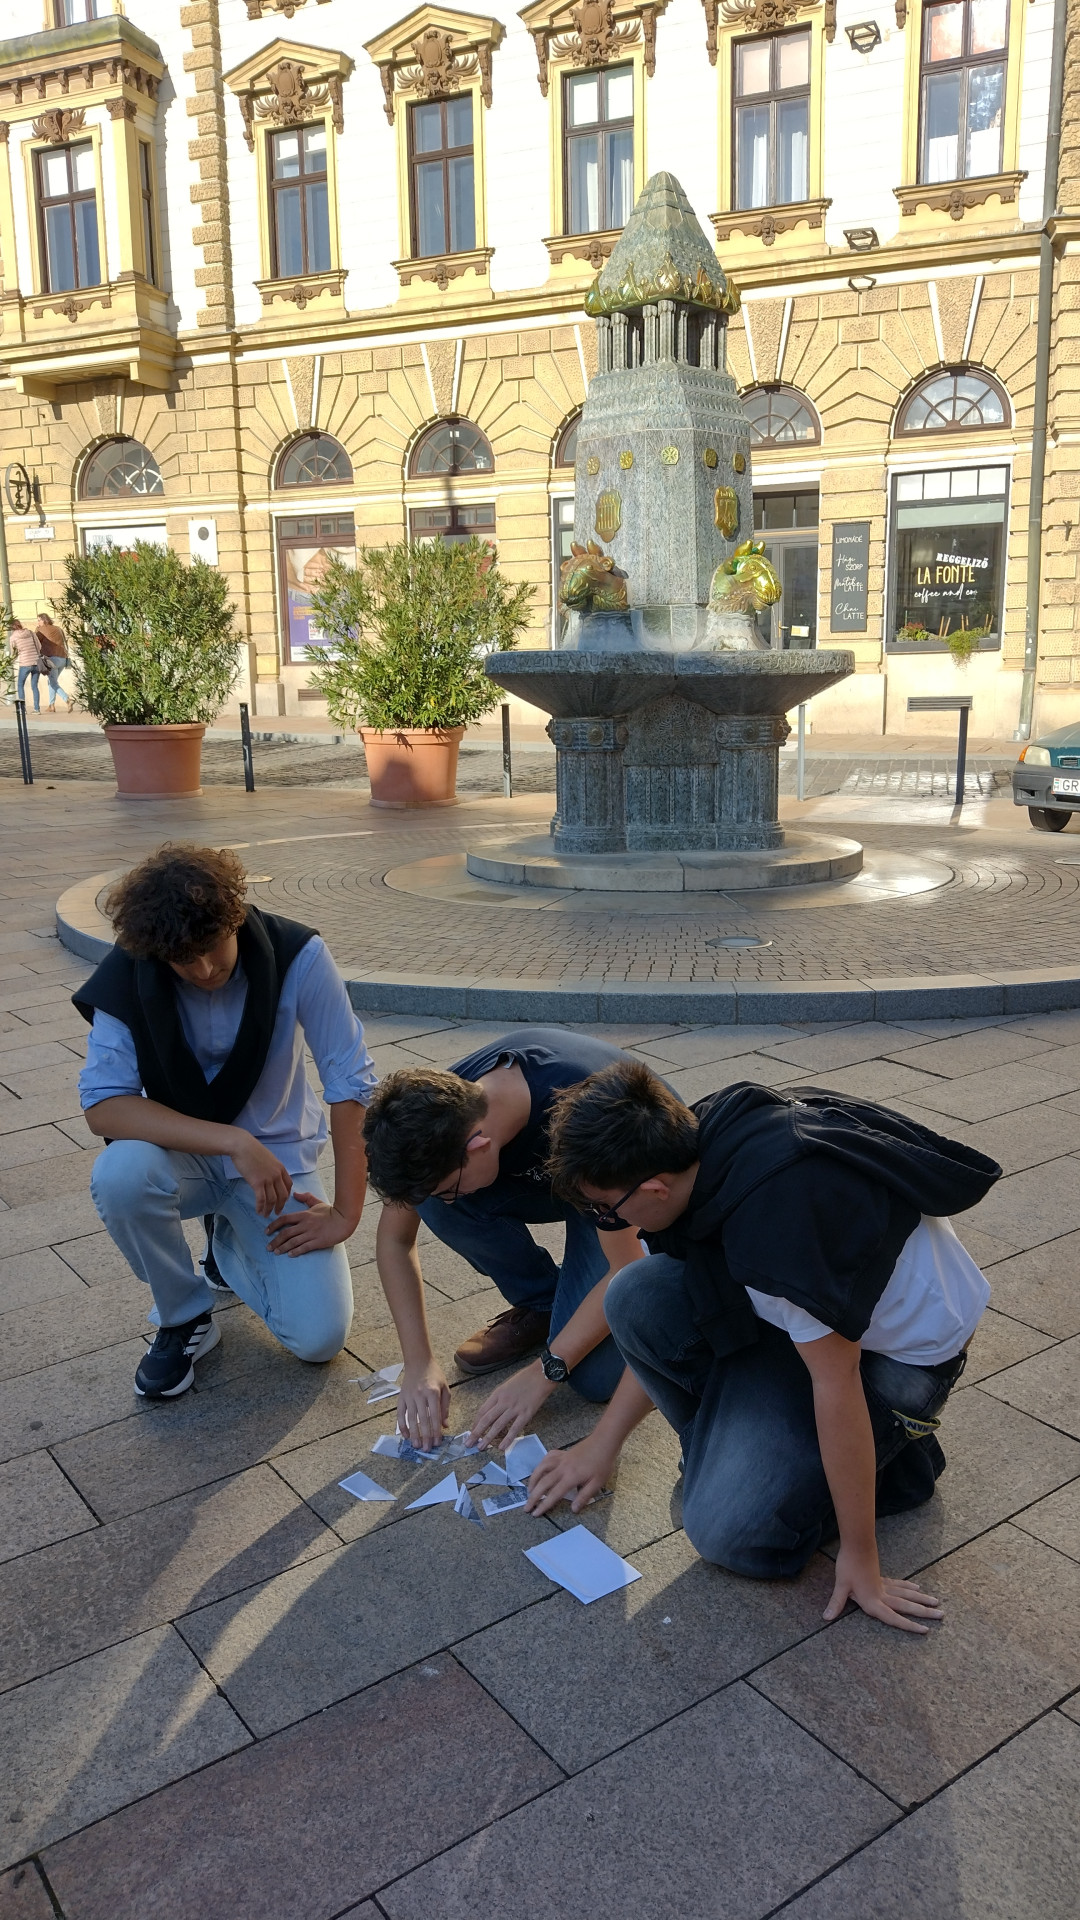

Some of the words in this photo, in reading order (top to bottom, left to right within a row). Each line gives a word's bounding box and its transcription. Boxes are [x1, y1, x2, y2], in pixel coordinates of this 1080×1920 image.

[936, 552, 989, 569] REGGELIZŐ
[917, 566, 931, 585] LA
[935, 564, 976, 584] FONTE
[914, 587, 941, 603] coffee
[942, 582, 965, 600] and
[843, 612, 865, 620] LATTE
